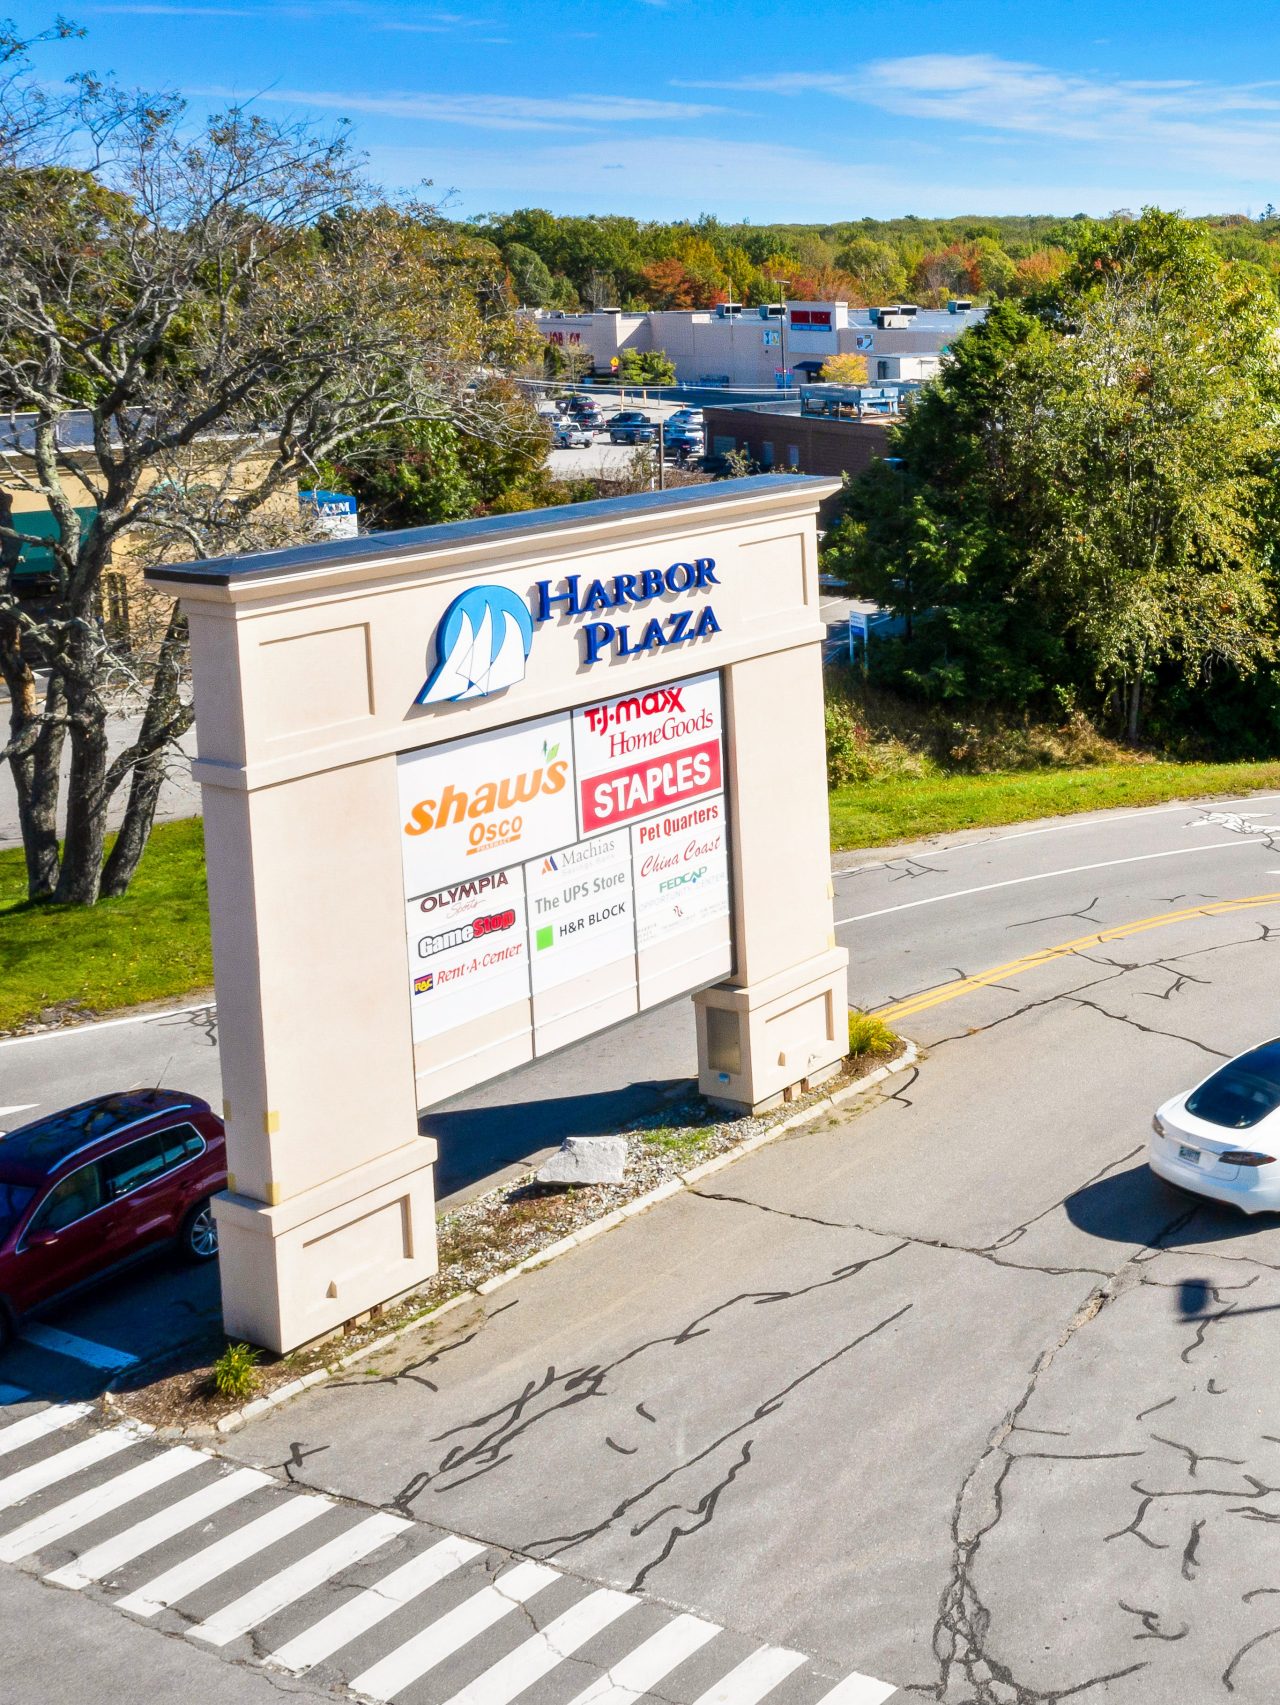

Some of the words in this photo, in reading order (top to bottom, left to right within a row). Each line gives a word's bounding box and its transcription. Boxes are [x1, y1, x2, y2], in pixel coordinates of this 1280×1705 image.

[535, 557, 721, 622] HARBOR
[582, 605, 723, 665] PLAZA
[609, 707, 714, 758] HomeGoods
[594, 752, 711, 818] STAPLES
[640, 823, 661, 844] Pet
[663, 805, 719, 837] Quarters
[562, 839, 615, 868] Machias
[640, 852, 680, 877] China
[683, 835, 721, 861] Coast
[420, 871, 509, 913] OLYMPIA
[534, 896, 560, 915] The
[563, 881, 589, 904] UPS
[593, 872, 625, 894] Store
[418, 908, 516, 958] GameStop
[559, 918, 585, 937] H&R
[588, 902, 626, 926] BLOCK
